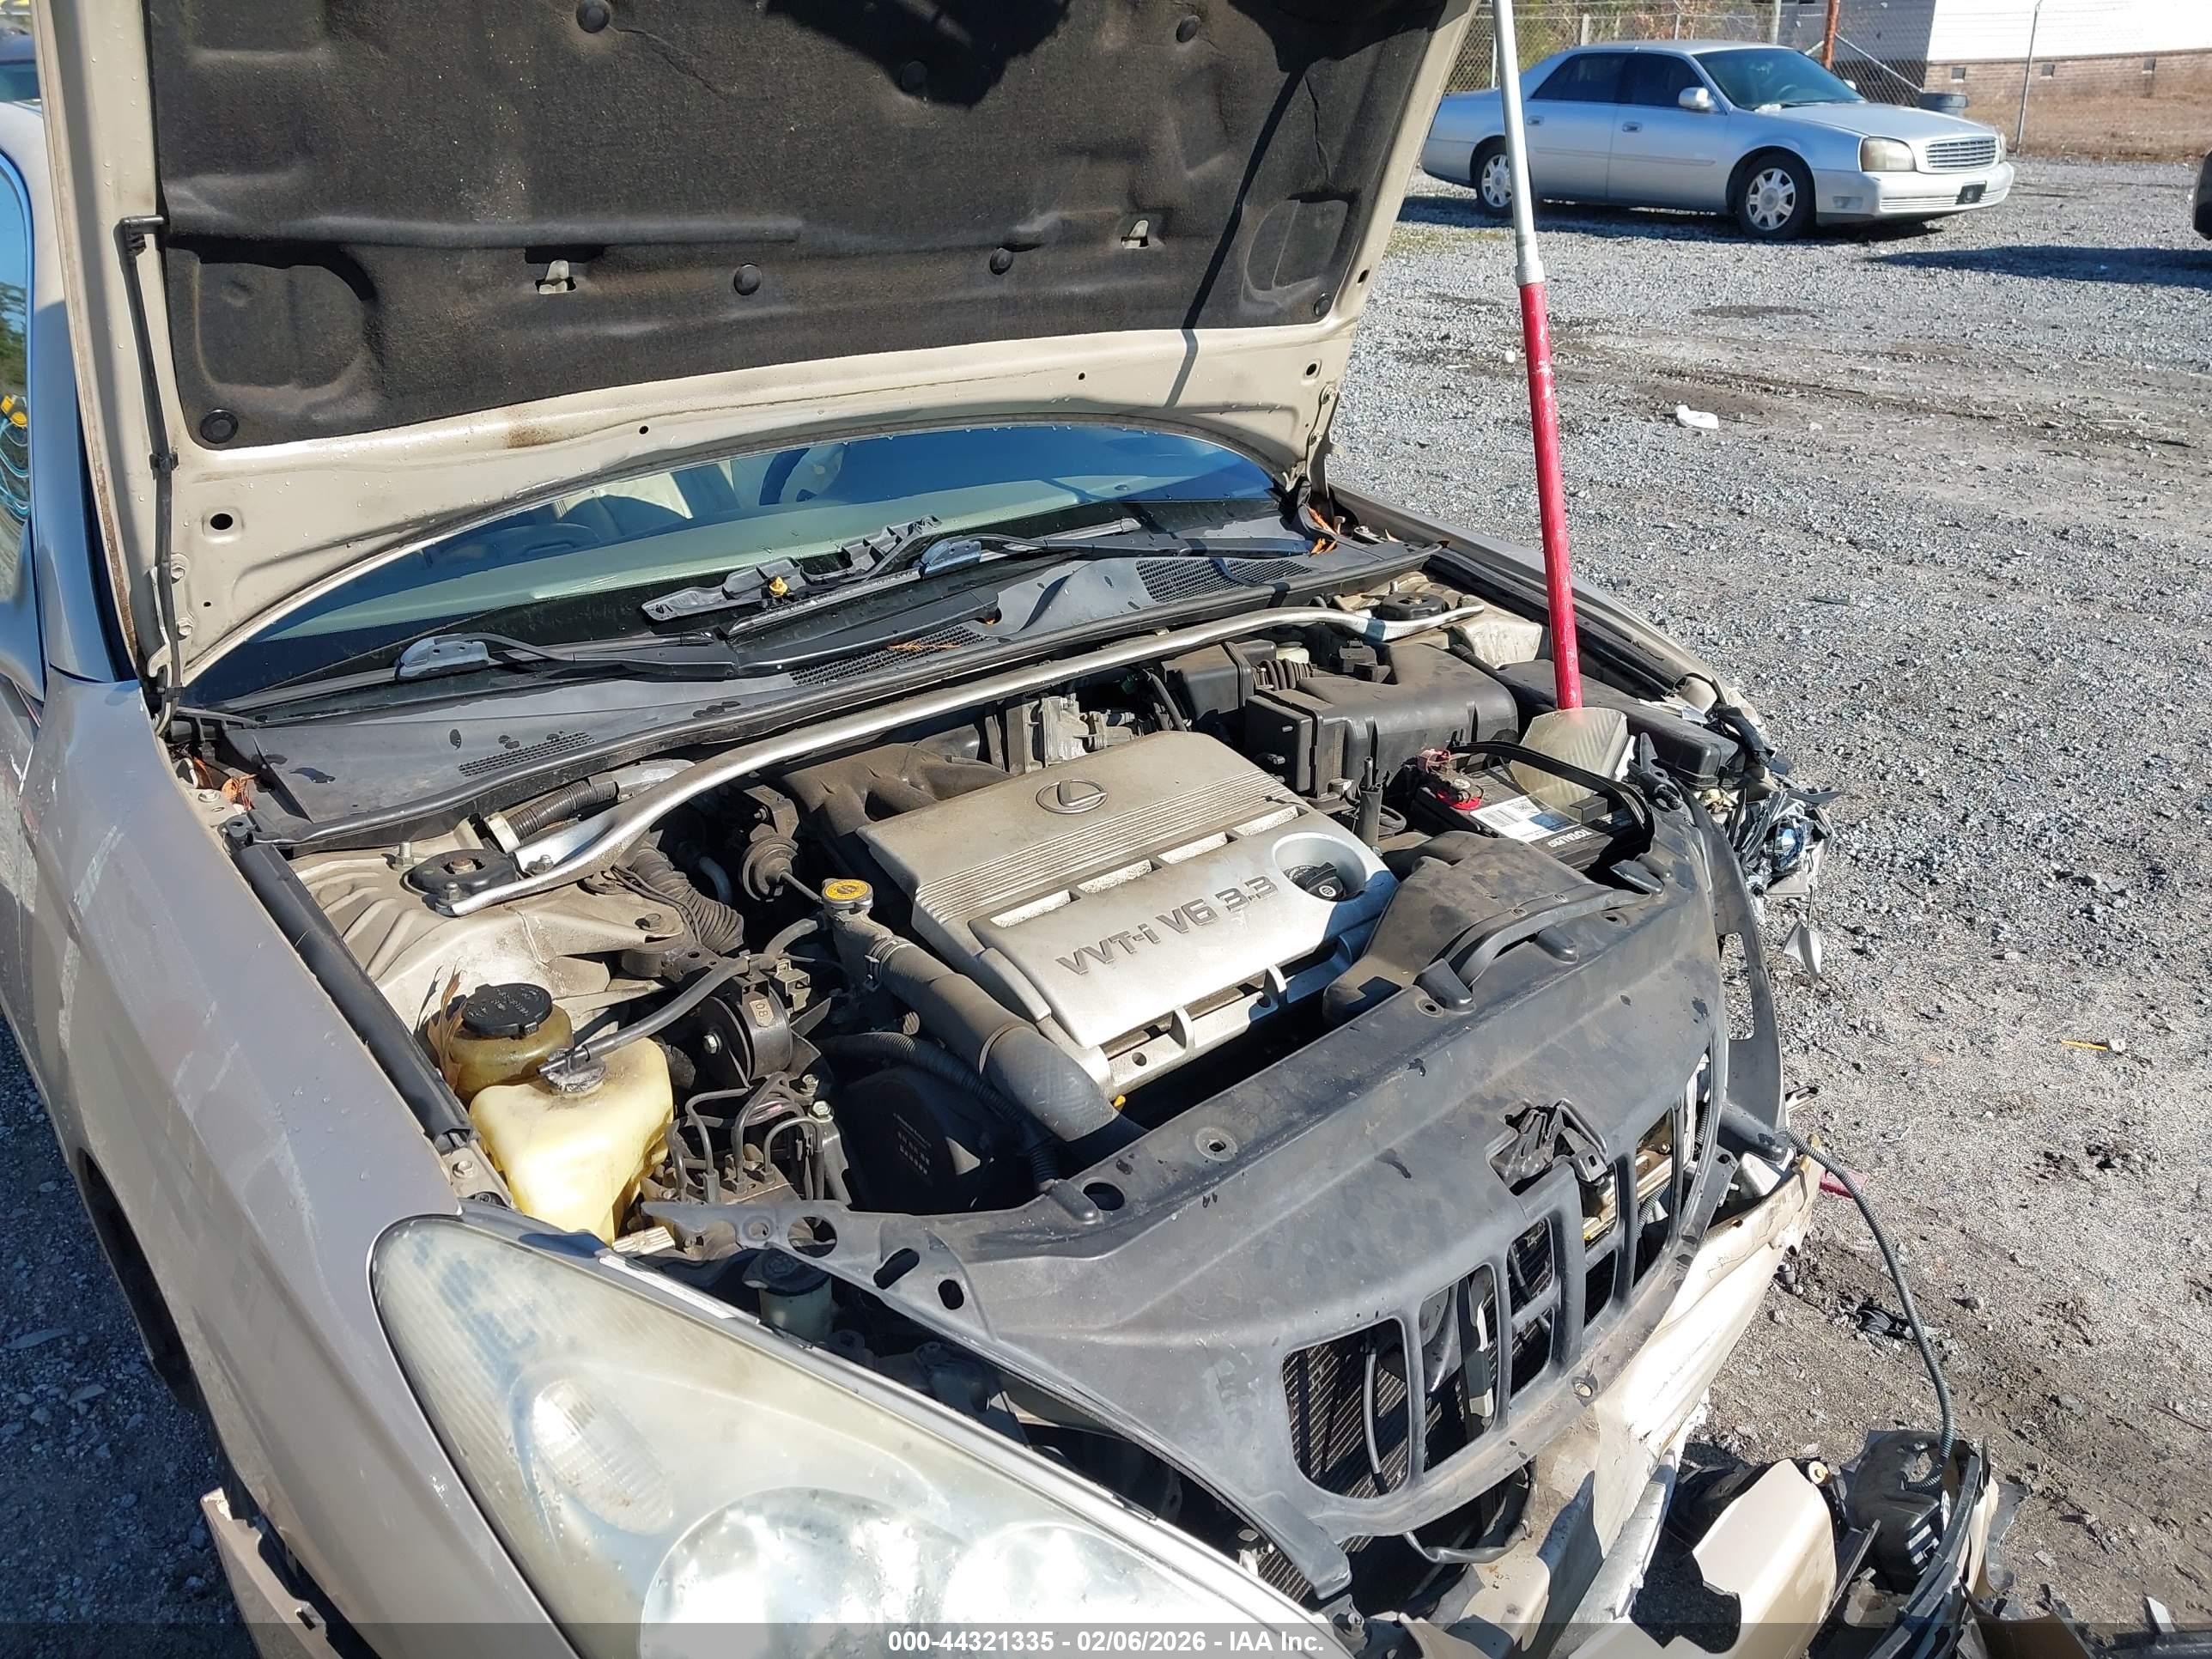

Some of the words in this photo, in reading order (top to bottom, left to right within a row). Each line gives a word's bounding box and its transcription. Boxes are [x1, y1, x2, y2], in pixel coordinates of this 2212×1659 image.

[1055, 923, 1161, 975] VVT-i
[1155, 897, 1218, 934] V6
[1214, 875, 1279, 912] 3.3
